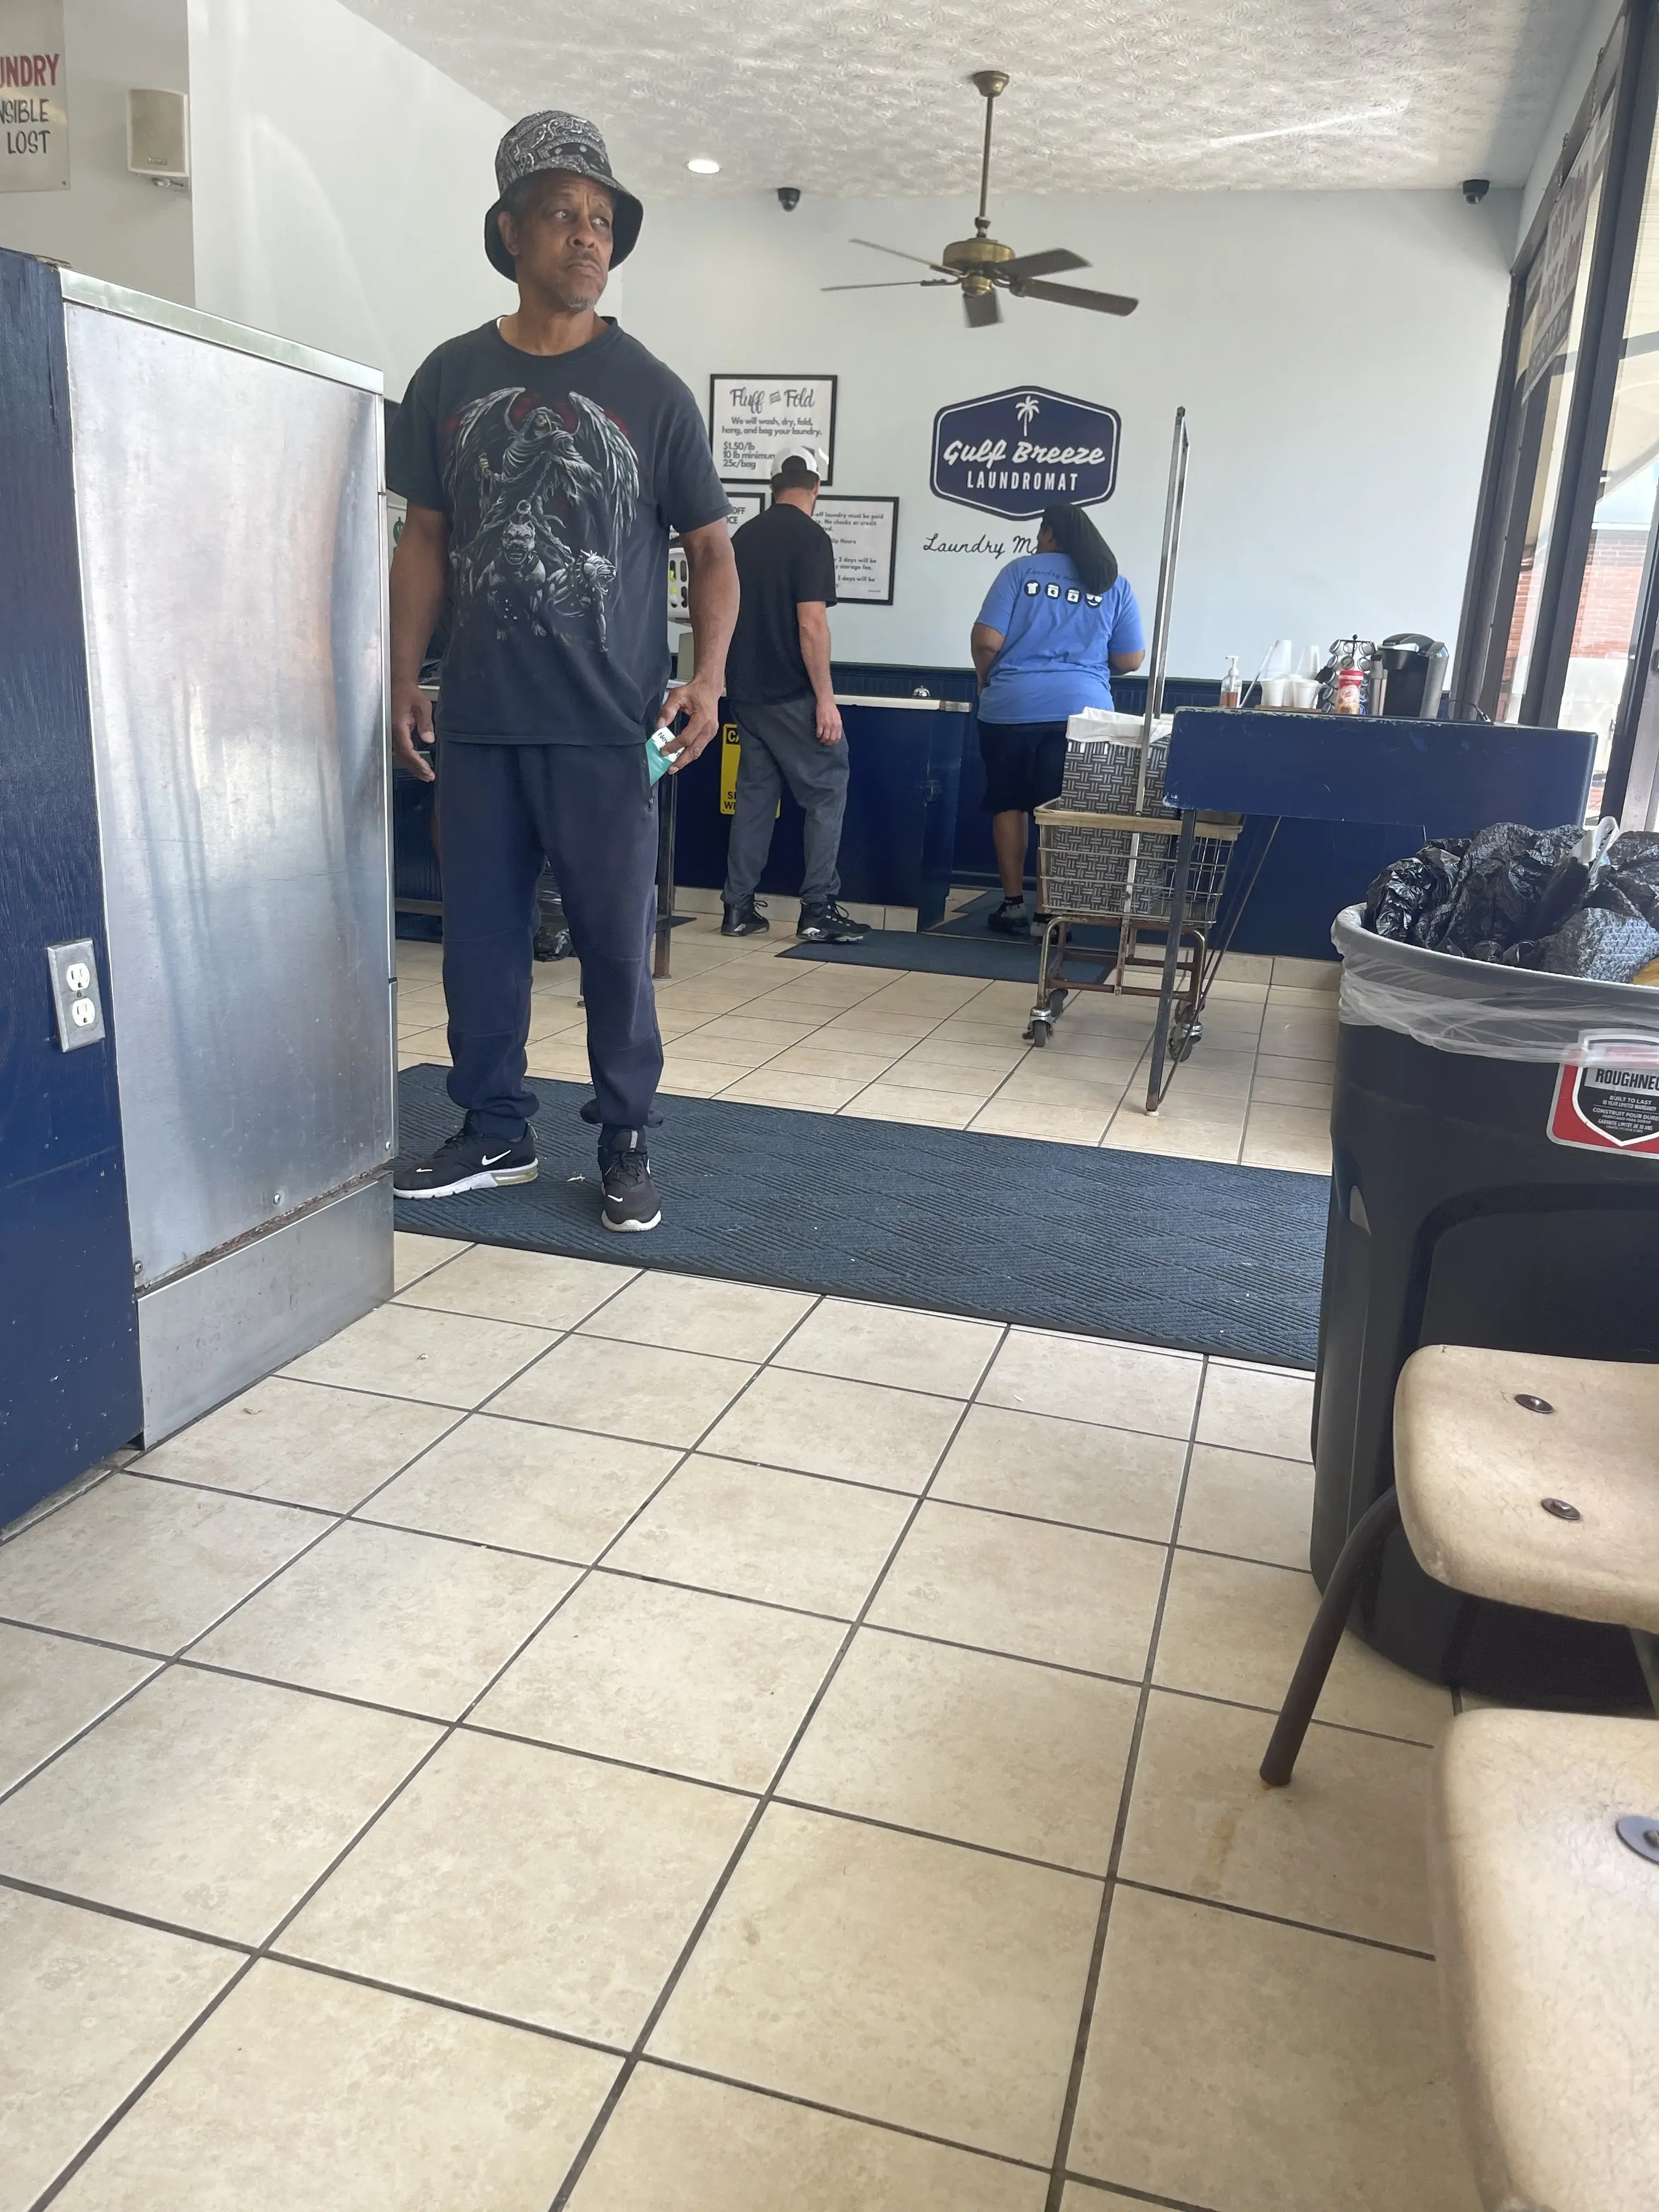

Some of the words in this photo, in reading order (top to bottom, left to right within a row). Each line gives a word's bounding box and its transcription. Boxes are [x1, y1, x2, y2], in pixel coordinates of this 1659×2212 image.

[7, 130, 50, 154] LOST
[730, 387, 765, 414] Fluff
[784, 387, 816, 408] Fold
[758, 417, 780, 425] wash,
[782, 417, 796, 427] dry,
[722, 426, 742, 435] hang,
[759, 426, 772, 436] bag
[792, 427, 822, 437] laundry.
[724, 441, 755, 451] $1.50/lb
[724, 450, 731, 458] 10
[733, 450, 740, 458] lb
[943, 439, 1007, 469] Gulf
[1012, 441, 1105, 465] Breeze
[967, 471, 1078, 491] LAUNDROMAT
[923, 533, 1006, 559] Laundry
[1593, 1108, 1625, 1116] CONSTRUIT
